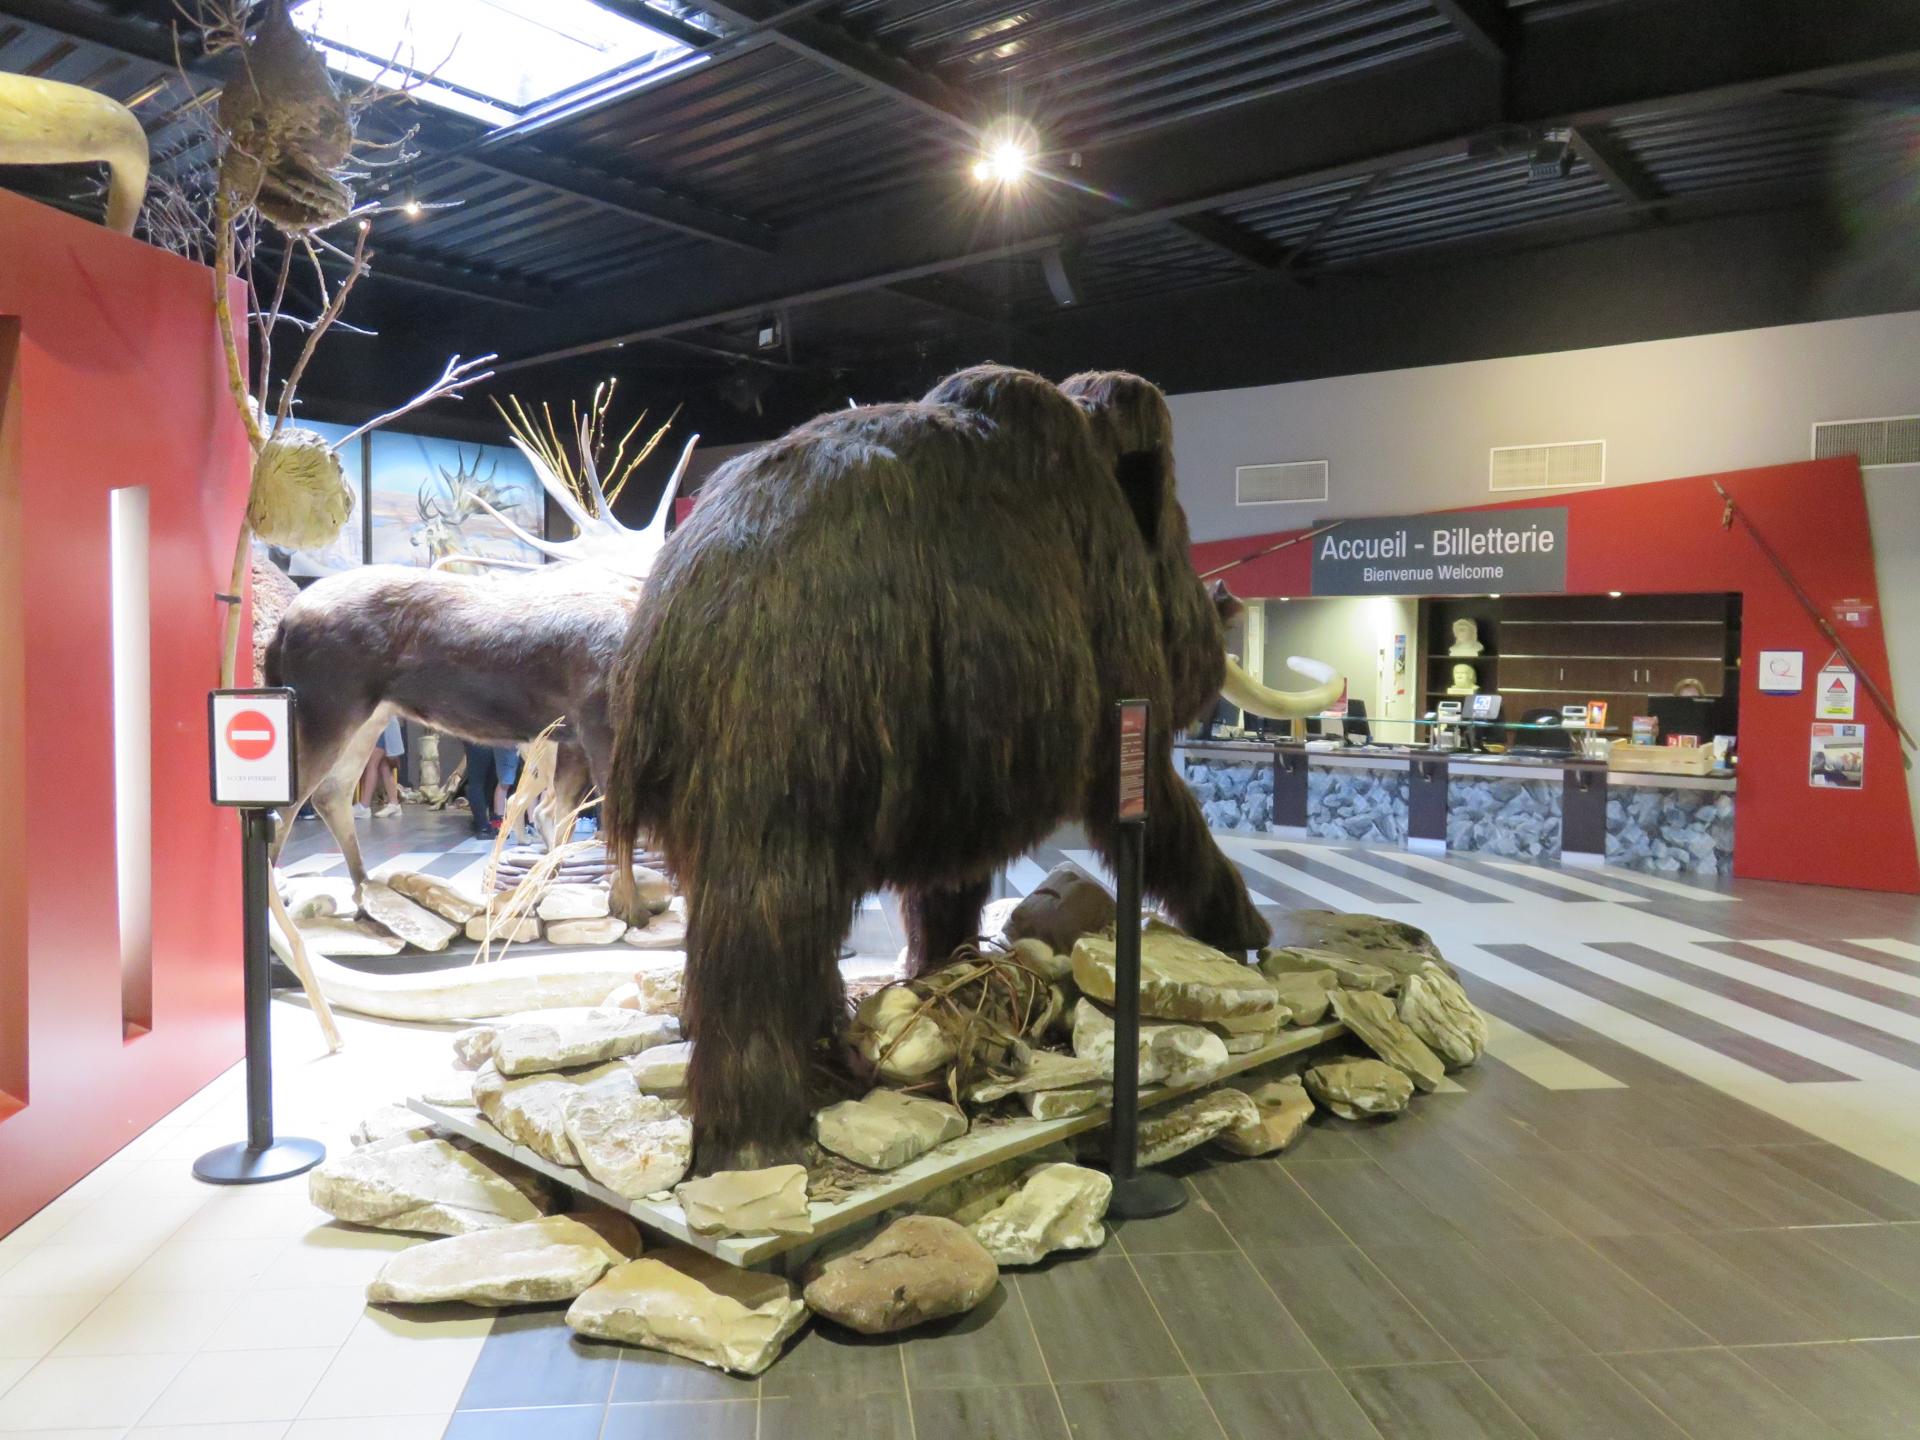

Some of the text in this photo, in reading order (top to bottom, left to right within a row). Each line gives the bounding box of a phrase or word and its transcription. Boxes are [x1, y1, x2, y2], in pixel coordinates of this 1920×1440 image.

[1320, 531, 1406, 560] Accueil
[1433, 524, 1555, 556] Billetterie
[1363, 564, 1503, 582] Bienvenue Welcome
